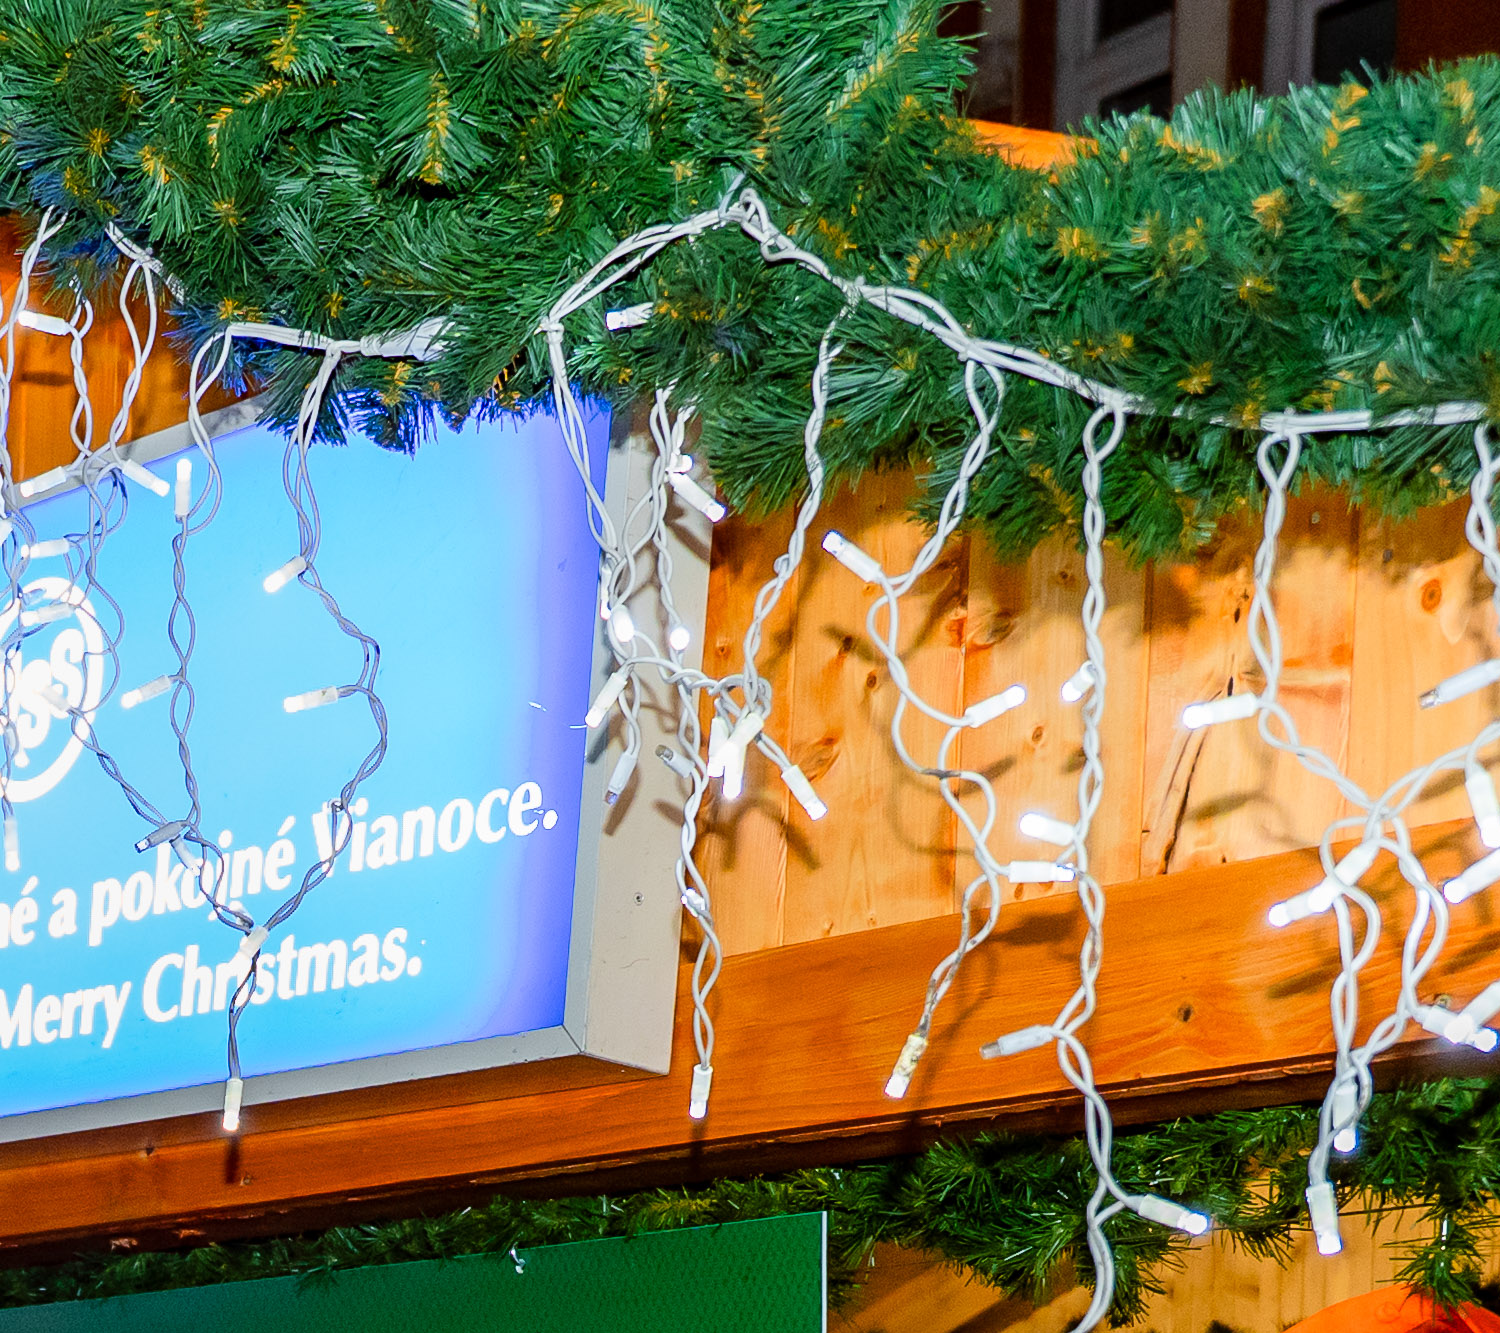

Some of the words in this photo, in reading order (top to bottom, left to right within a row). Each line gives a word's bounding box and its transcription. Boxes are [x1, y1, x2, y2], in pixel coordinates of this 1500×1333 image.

[47, 887, 78, 939] a
[88, 815, 296, 947] pokojné
[312, 781, 559, 877] Vianoce.
[142, 927, 423, 1023] Christmas.
